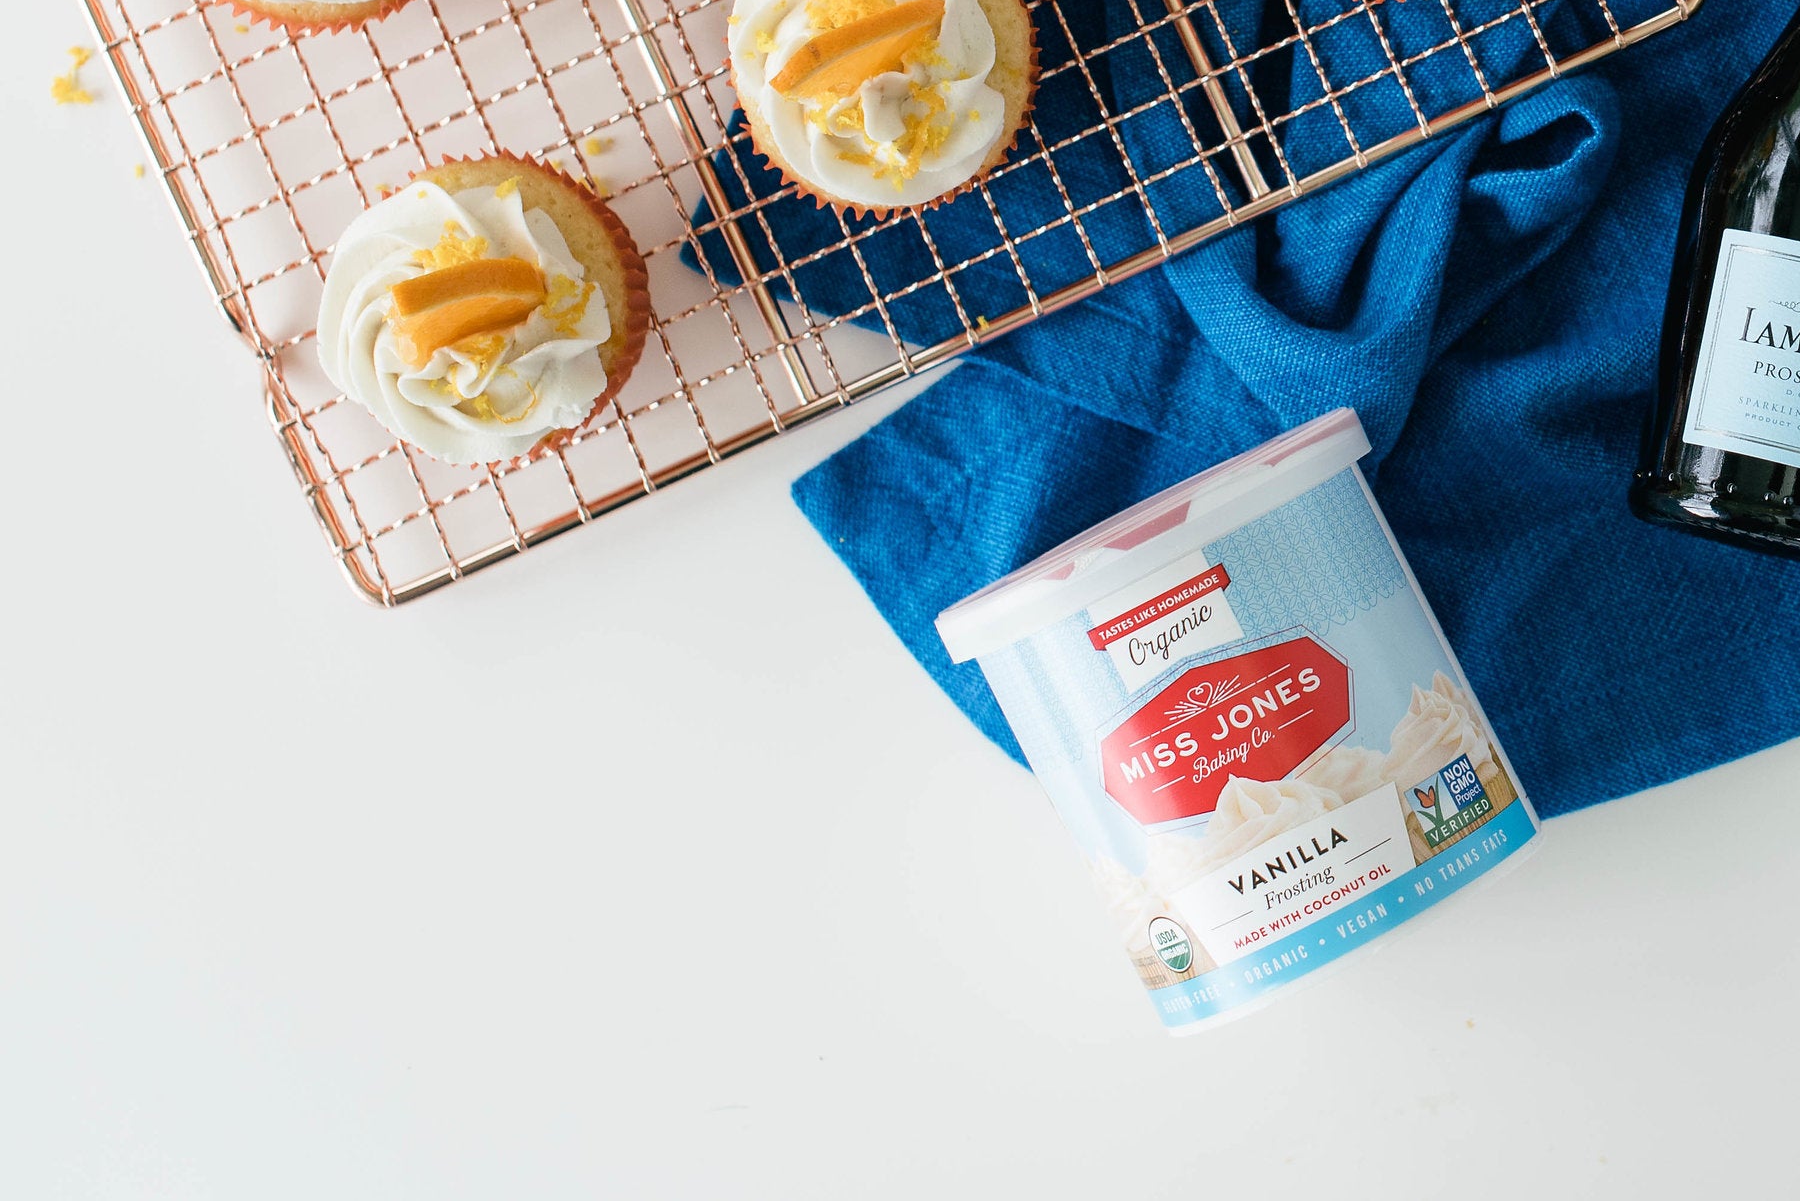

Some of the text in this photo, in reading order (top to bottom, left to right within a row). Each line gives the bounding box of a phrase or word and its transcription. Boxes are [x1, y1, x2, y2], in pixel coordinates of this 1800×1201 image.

[1745, 412, 1791, 427] PRODUCT
[1098, 574, 1220, 640] TASTES LIKE HOMEMADE
[1128, 605, 1212, 666] Organic
[1119, 667, 1321, 784] MISS JONES
[1192, 726, 1276, 783] Baking Co.
[1443, 758, 1471, 784] NON
[1450, 770, 1476, 795] GMO
[1455, 784, 1482, 806] Project
[1430, 798, 1489, 843] VERIFIED
[1228, 827, 1348, 895] VANILLA
[1234, 864, 1392, 949] MADE WITH COCONUT OIL
[1244, 945, 1308, 984] ORGANIC
[1336, 903, 1388, 939] VEGAN
[1414, 876, 1434, 896] NO
[1438, 848, 1480, 882] TRANS
[1481, 829, 1508, 854] FATS
[1264, 866, 1335, 910] Frosting
[1155, 928, 1178, 945] USDA
